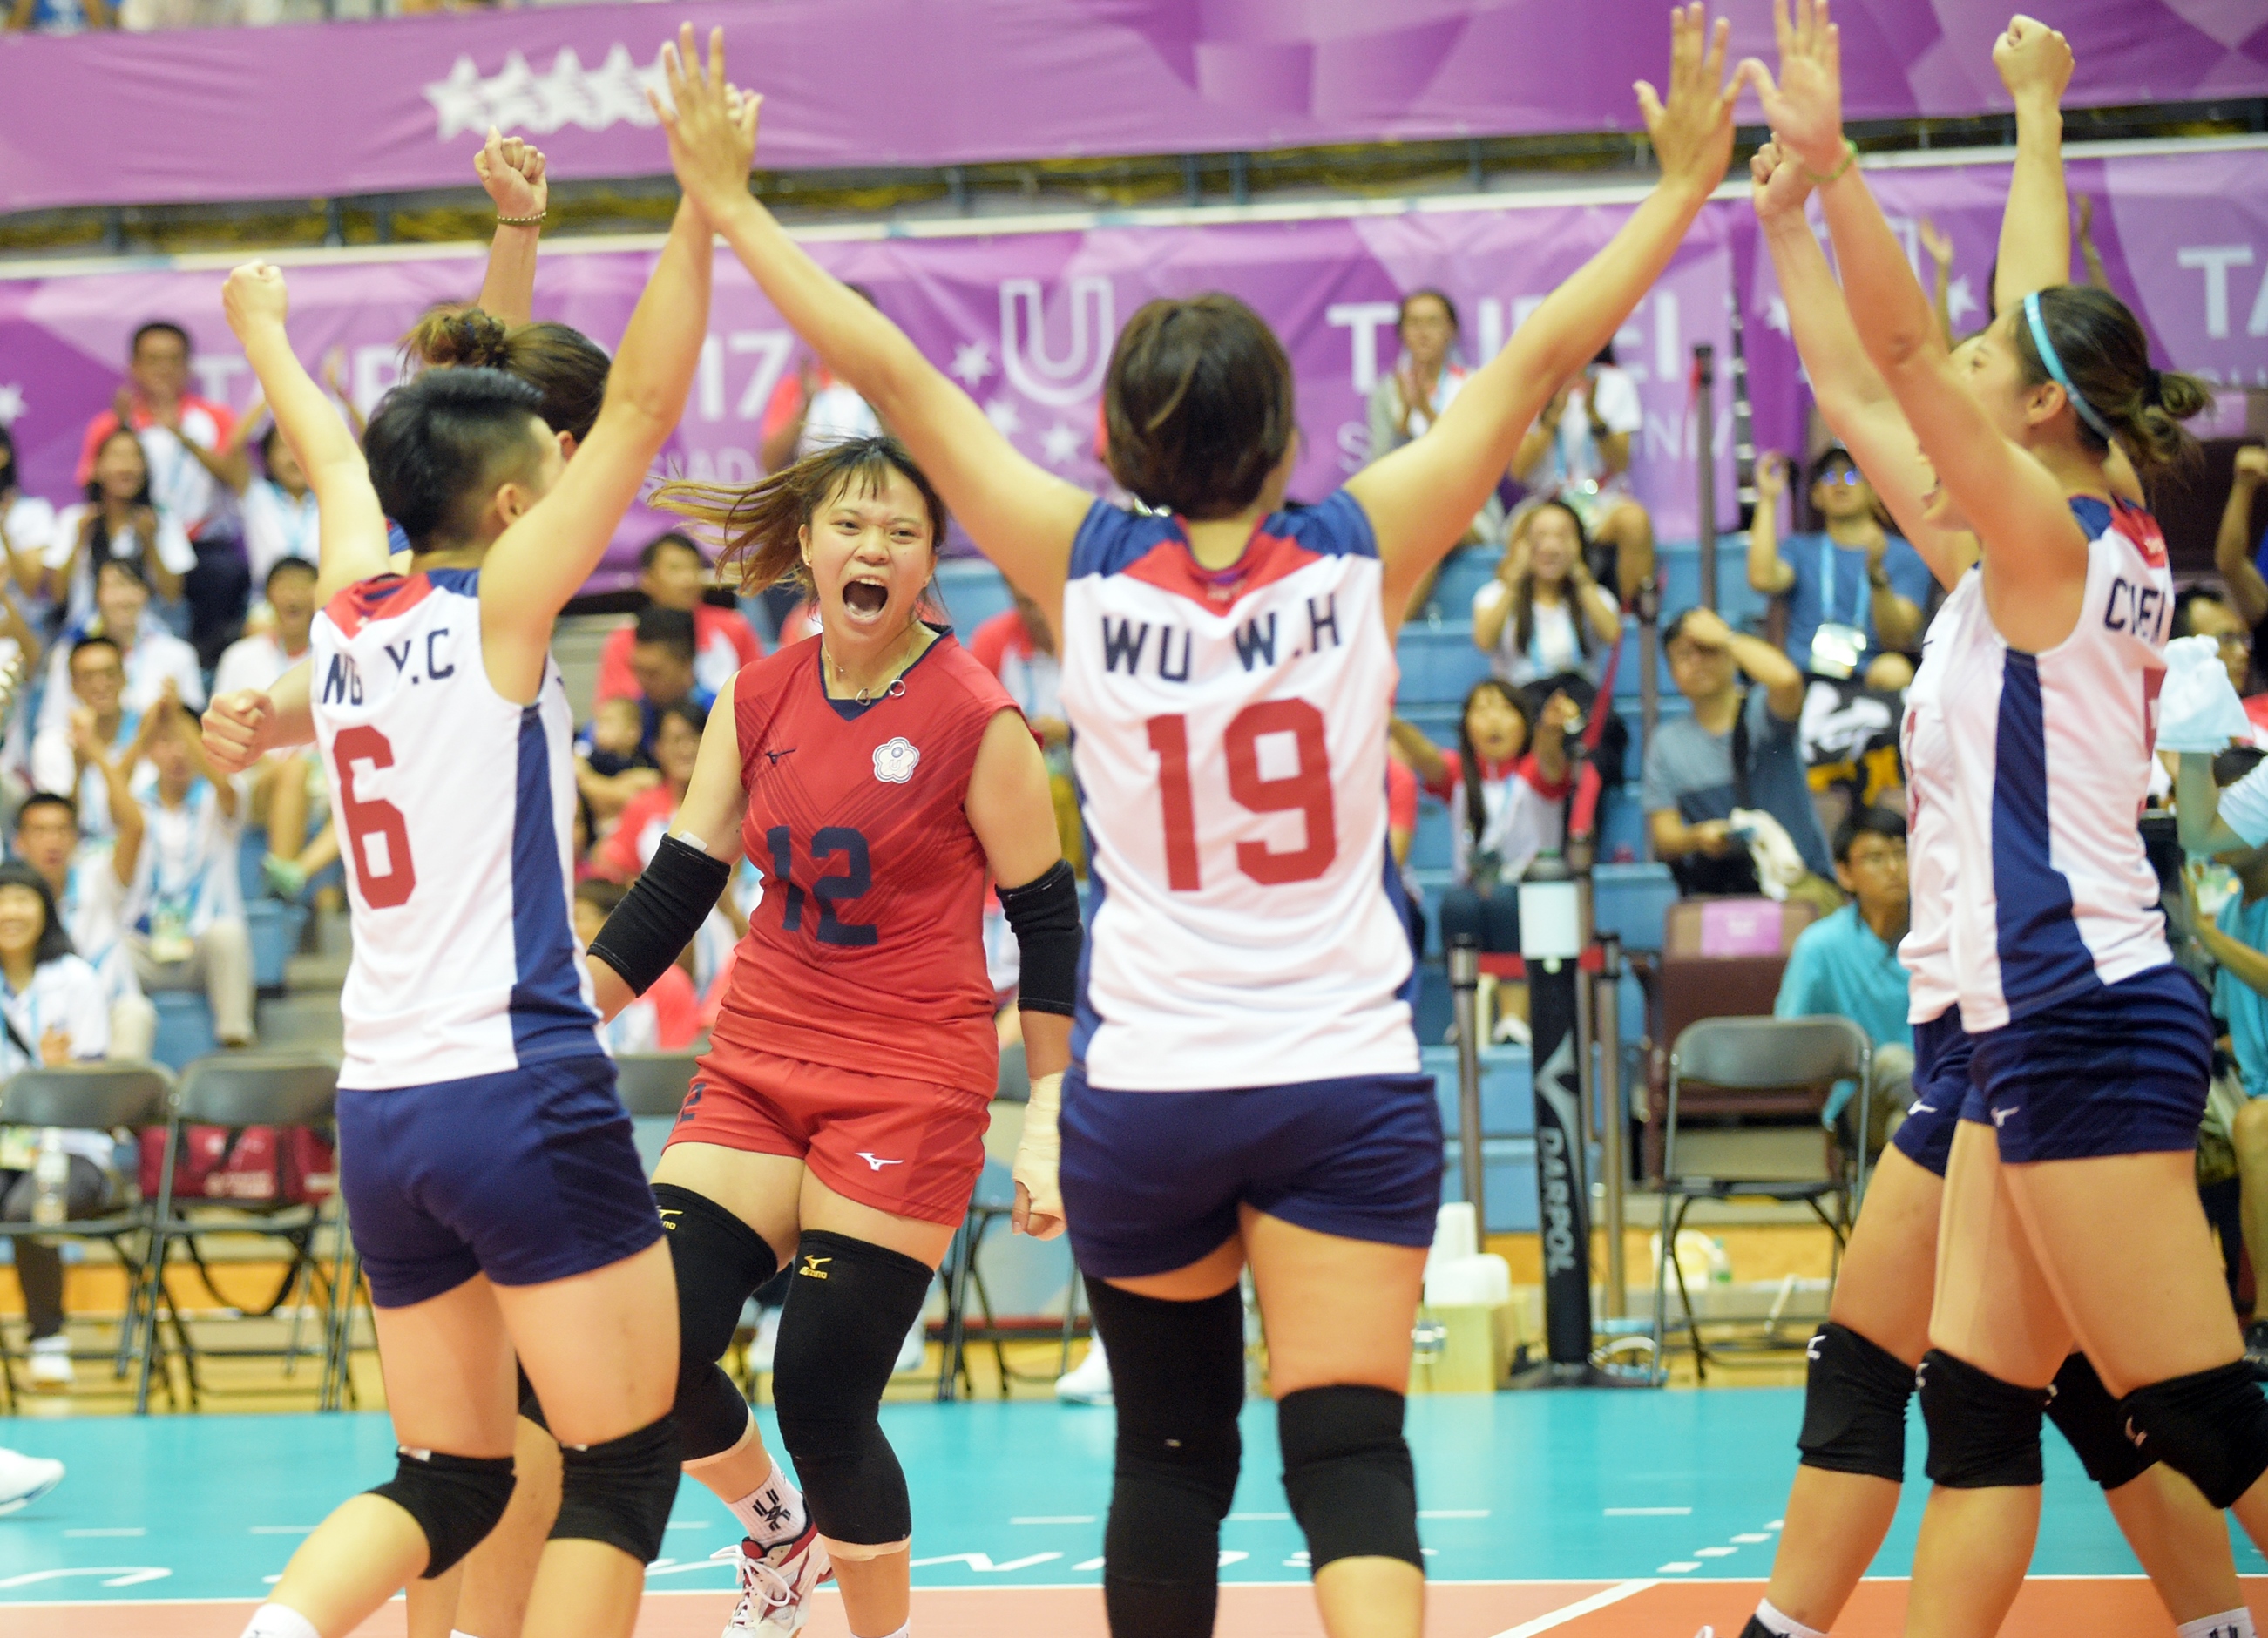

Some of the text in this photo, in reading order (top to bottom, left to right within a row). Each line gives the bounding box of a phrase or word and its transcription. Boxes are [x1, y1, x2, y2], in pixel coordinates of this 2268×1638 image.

[1102, 592, 1340, 682] WU W.H
[332, 724, 416, 910] 6
[1145, 696, 1339, 891] 19
[767, 825, 878, 946] 12
[1538, 1127, 1578, 1278] DARPOL
